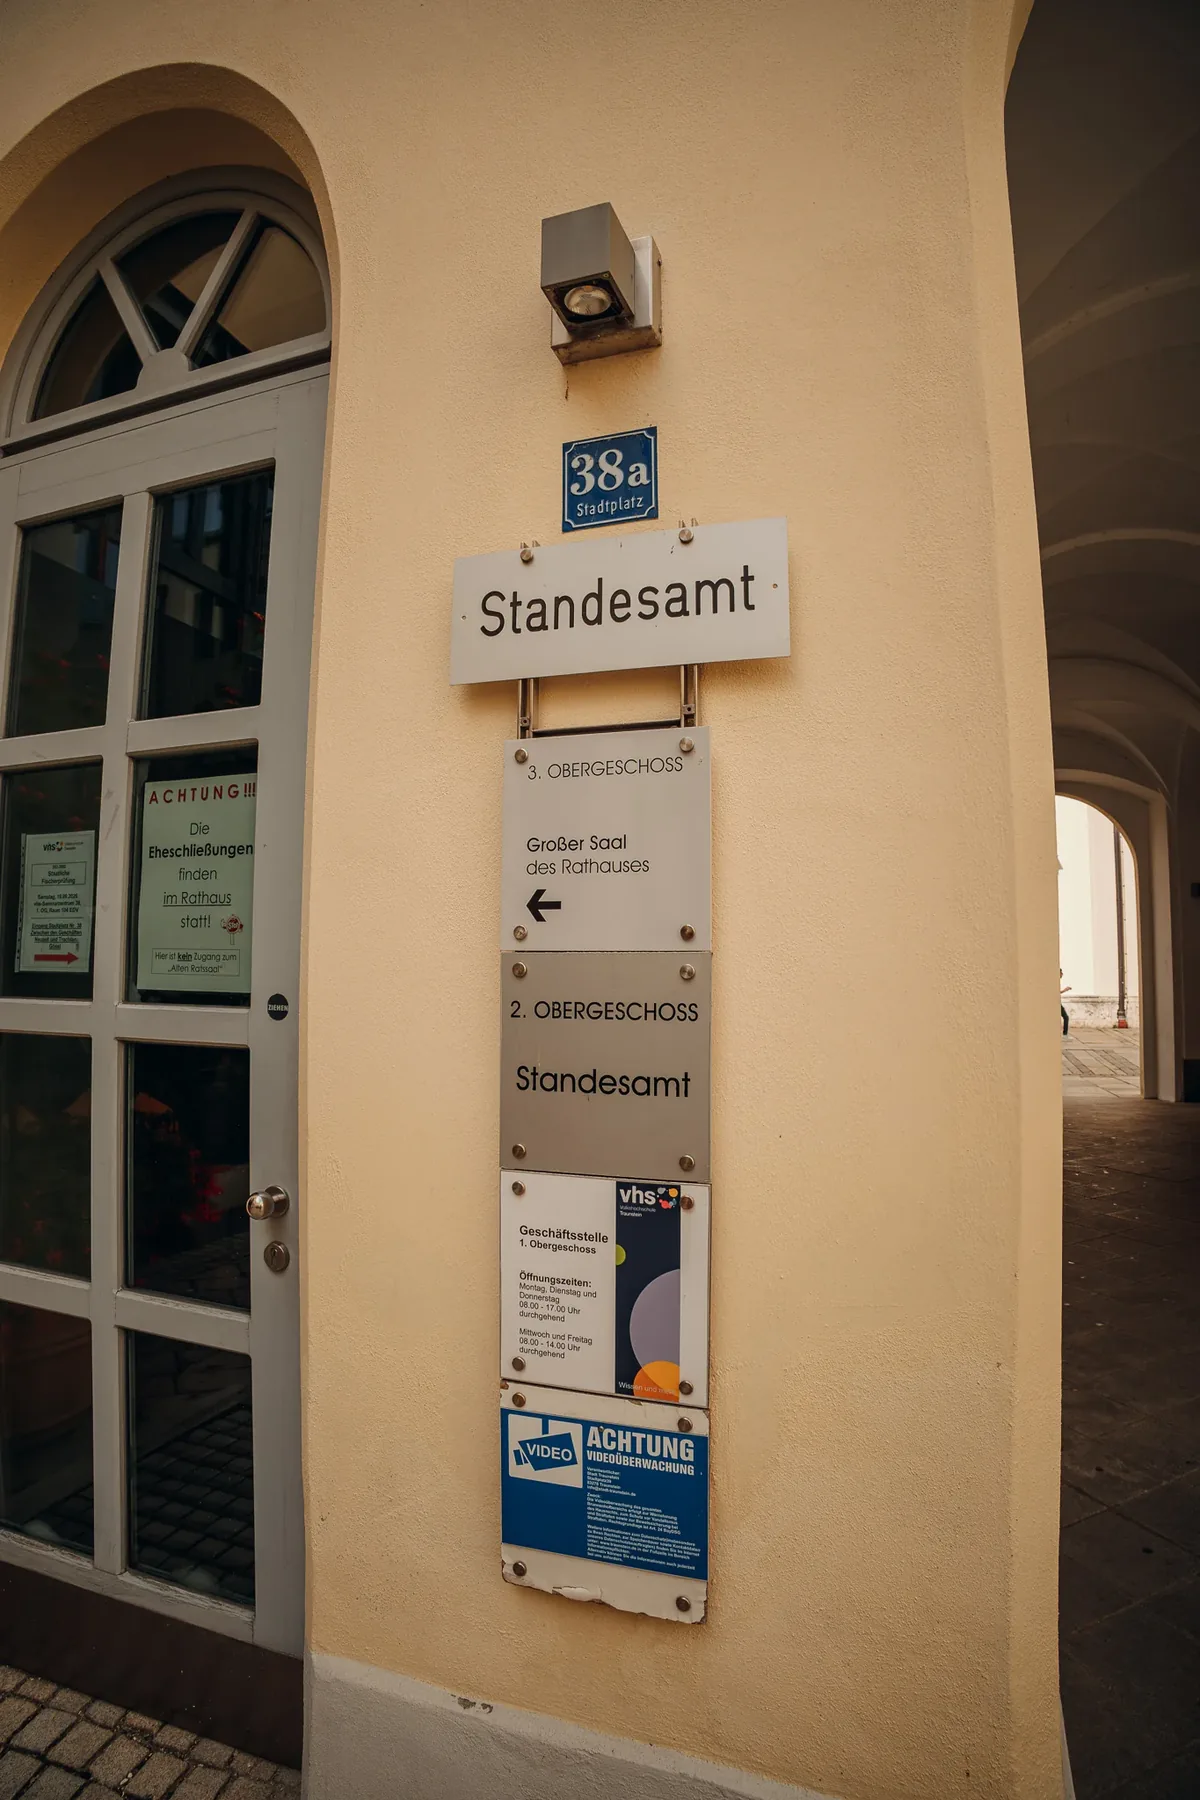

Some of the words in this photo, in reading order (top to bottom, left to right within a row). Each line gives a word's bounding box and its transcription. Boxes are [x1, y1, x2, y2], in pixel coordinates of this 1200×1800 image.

[570, 449, 651, 496] 38a
[577, 496, 644, 516] Stadtplatz
[480, 565, 755, 637] Standesamt
[528, 765, 541, 780] 3.
[548, 756, 683, 778] OBERGESCHOSS
[149, 783, 256, 804] ACHTUNG!!!
[190, 822, 210, 836] Die
[149, 842, 254, 858] Eheschließungen
[527, 836, 584, 852] Großer
[590, 834, 626, 850] Saal
[178, 868, 218, 880] finden
[526, 860, 556, 875] des
[562, 859, 650, 875] Rathauses
[164, 892, 178, 905] im
[181, 892, 232, 904] Rathaus
[180, 914, 211, 928] statt!
[155, 952, 168, 960] Hier
[177, 952, 192, 961] kein
[194, 952, 220, 962] Zugang
[510, 1000, 526, 1018] 2.
[534, 1001, 698, 1021] OBERGESCHOSS
[516, 1065, 690, 1098] Standesamt
[620, 1186, 656, 1205] vhs
[520, 1225, 608, 1243] Geschäftsstelle
[520, 1239, 527, 1247] 1.
[530, 1240, 596, 1254] Obergeschoss
[520, 1270, 592, 1288] Öffnungszeiten:
[519, 1283, 548, 1294] Montag,
[550, 1286, 581, 1298] Dienstag
[583, 1290, 597, 1298] und
[519, 1292, 560, 1304] Donnerstag
[519, 1301, 538, 1310] 08.00
[546, 1304, 566, 1313] 17.00
[568, 1306, 581, 1315] Uhr
[519, 1310, 565, 1322] durchgehend
[519, 1328, 550, 1338] Mittwoch
[552, 1332, 566, 1340] und
[568, 1334, 592, 1346] Freitag
[519, 1338, 538, 1347] 08.00
[546, 1340, 566, 1350] 14.00
[568, 1343, 581, 1351] Uhr
[519, 1347, 565, 1359] durchgehend
[526, 1444, 572, 1462] VIDEO
[587, 1426, 695, 1462] ACHTUNG
[587, 1450, 695, 1475] VIDEOÜBERWACHUNG
